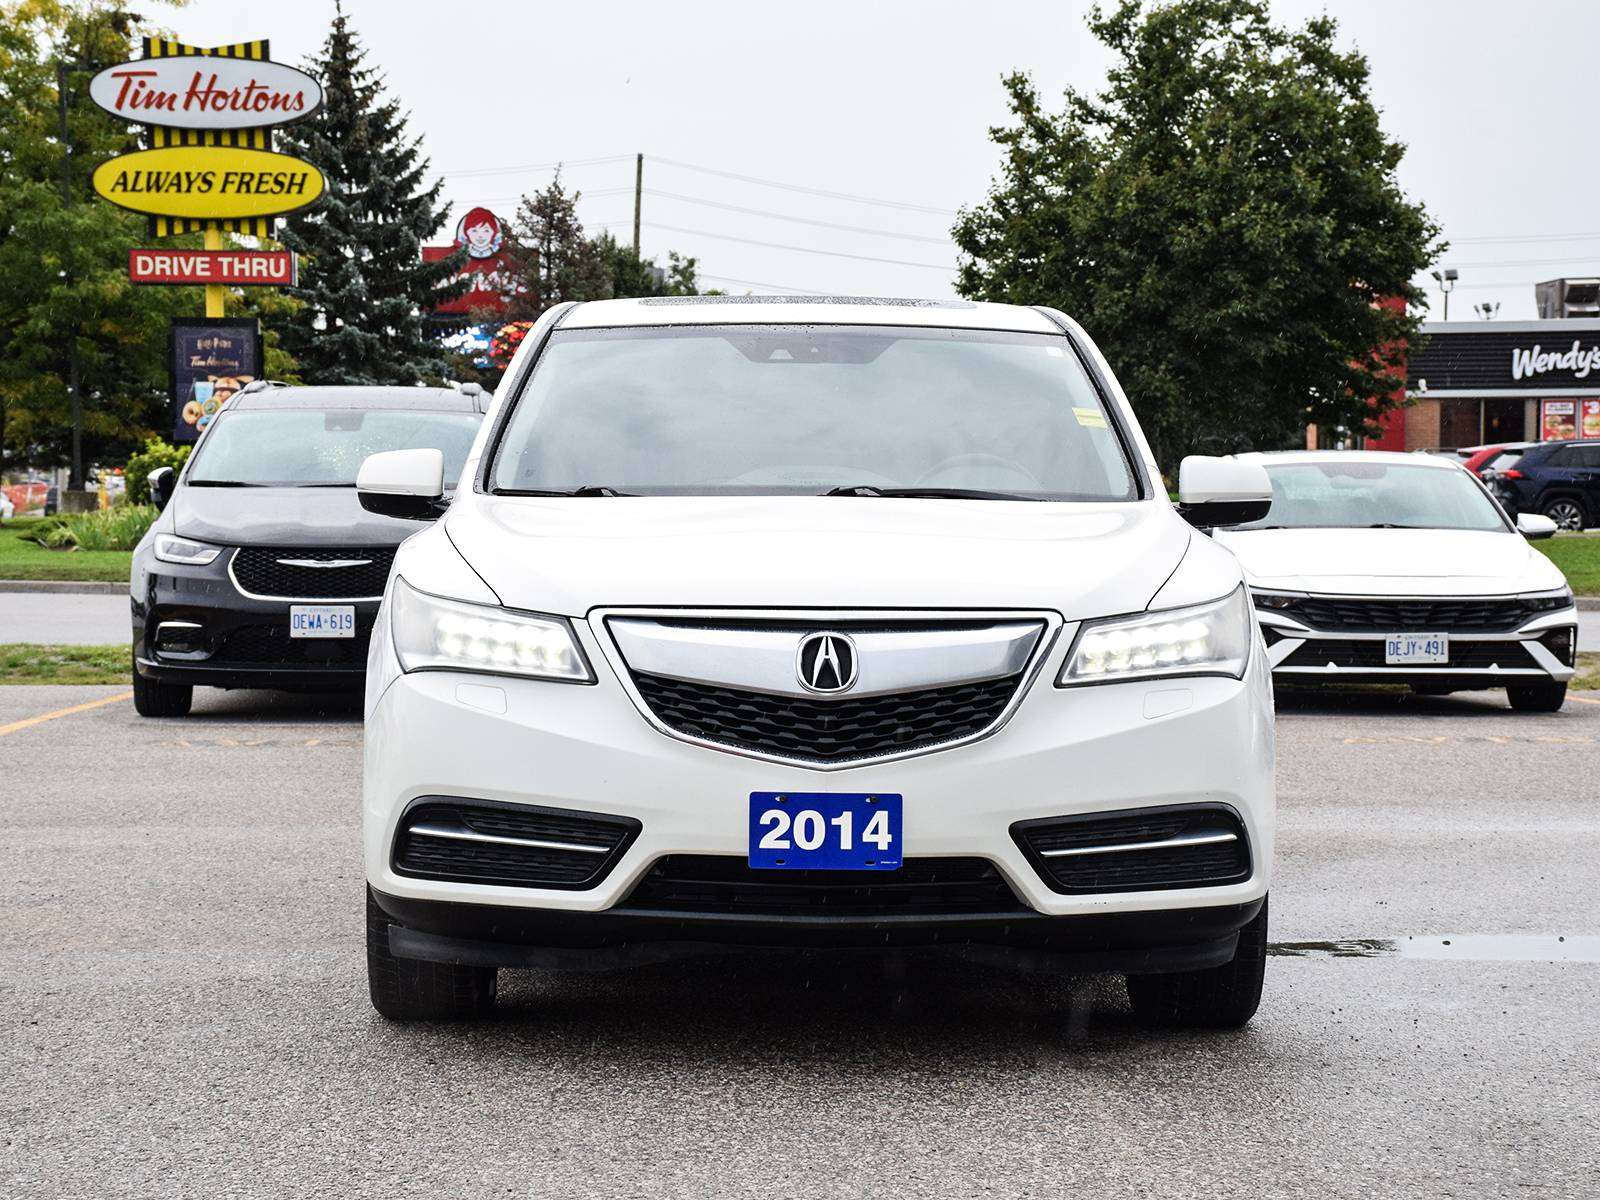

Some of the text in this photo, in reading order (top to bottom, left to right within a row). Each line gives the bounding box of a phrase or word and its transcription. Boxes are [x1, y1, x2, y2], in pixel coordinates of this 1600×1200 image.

[111, 71, 305, 112] Tim Hortons
[110, 170, 309, 195] ALWAYS FRESH
[136, 255, 286, 278] DRIVE THRU
[1512, 340, 1600, 380] Wendy's
[758, 809, 893, 851] 2014
